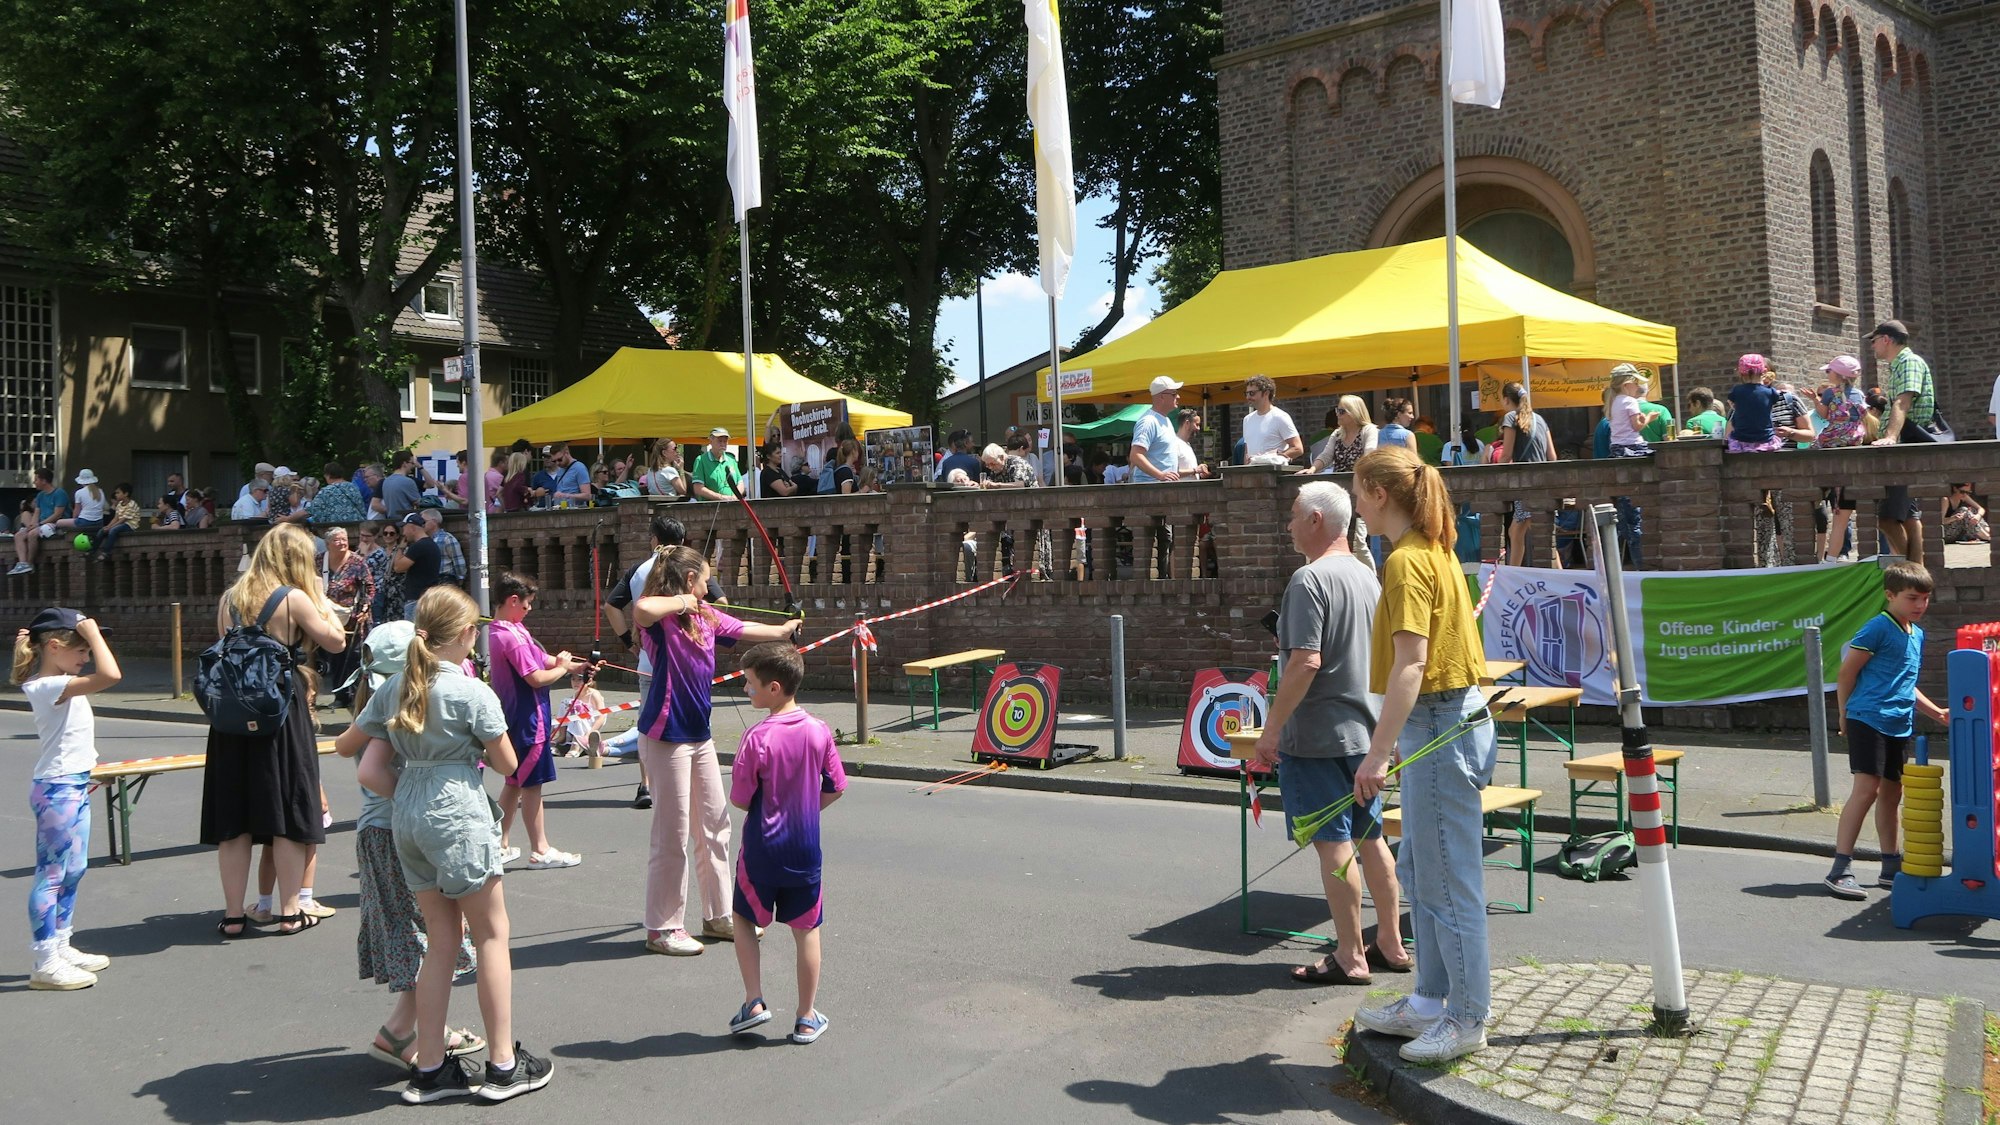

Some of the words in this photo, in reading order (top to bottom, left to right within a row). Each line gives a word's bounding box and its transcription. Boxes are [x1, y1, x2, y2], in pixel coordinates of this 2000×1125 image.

[791, 405, 832, 427] Rochuskirche
[1515, 581, 1547, 600] TÜR
[1659, 621, 1714, 636] Offene
[1722, 619, 1785, 635] Kinder-
[1792, 612, 1825, 630] und
[1014, 710, 1023, 719] 10
[1226, 720, 1237, 731] 10
